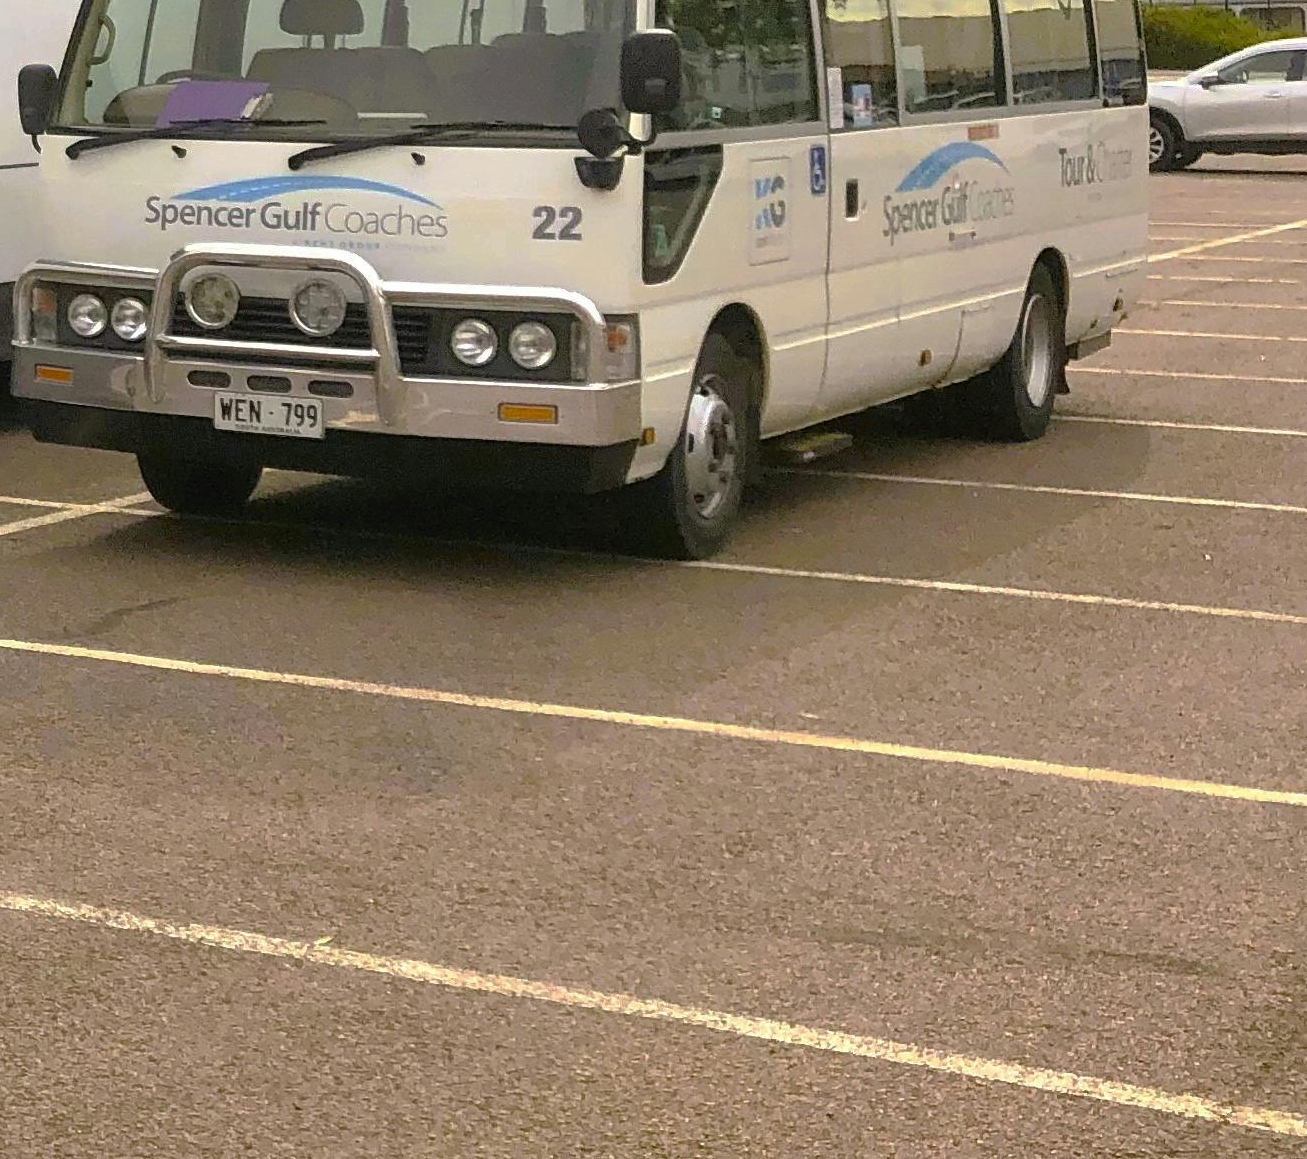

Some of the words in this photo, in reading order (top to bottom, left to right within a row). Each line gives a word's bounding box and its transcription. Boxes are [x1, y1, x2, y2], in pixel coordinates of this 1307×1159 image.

[1058, 148, 1085, 188] Tour
[144, 195, 256, 231] Spencer
[259, 201, 323, 231] Gulf
[324, 202, 449, 239] Coaches
[531, 205, 583, 241] 22
[882, 194, 939, 246] Spencer
[941, 179, 968, 226] Gulf
